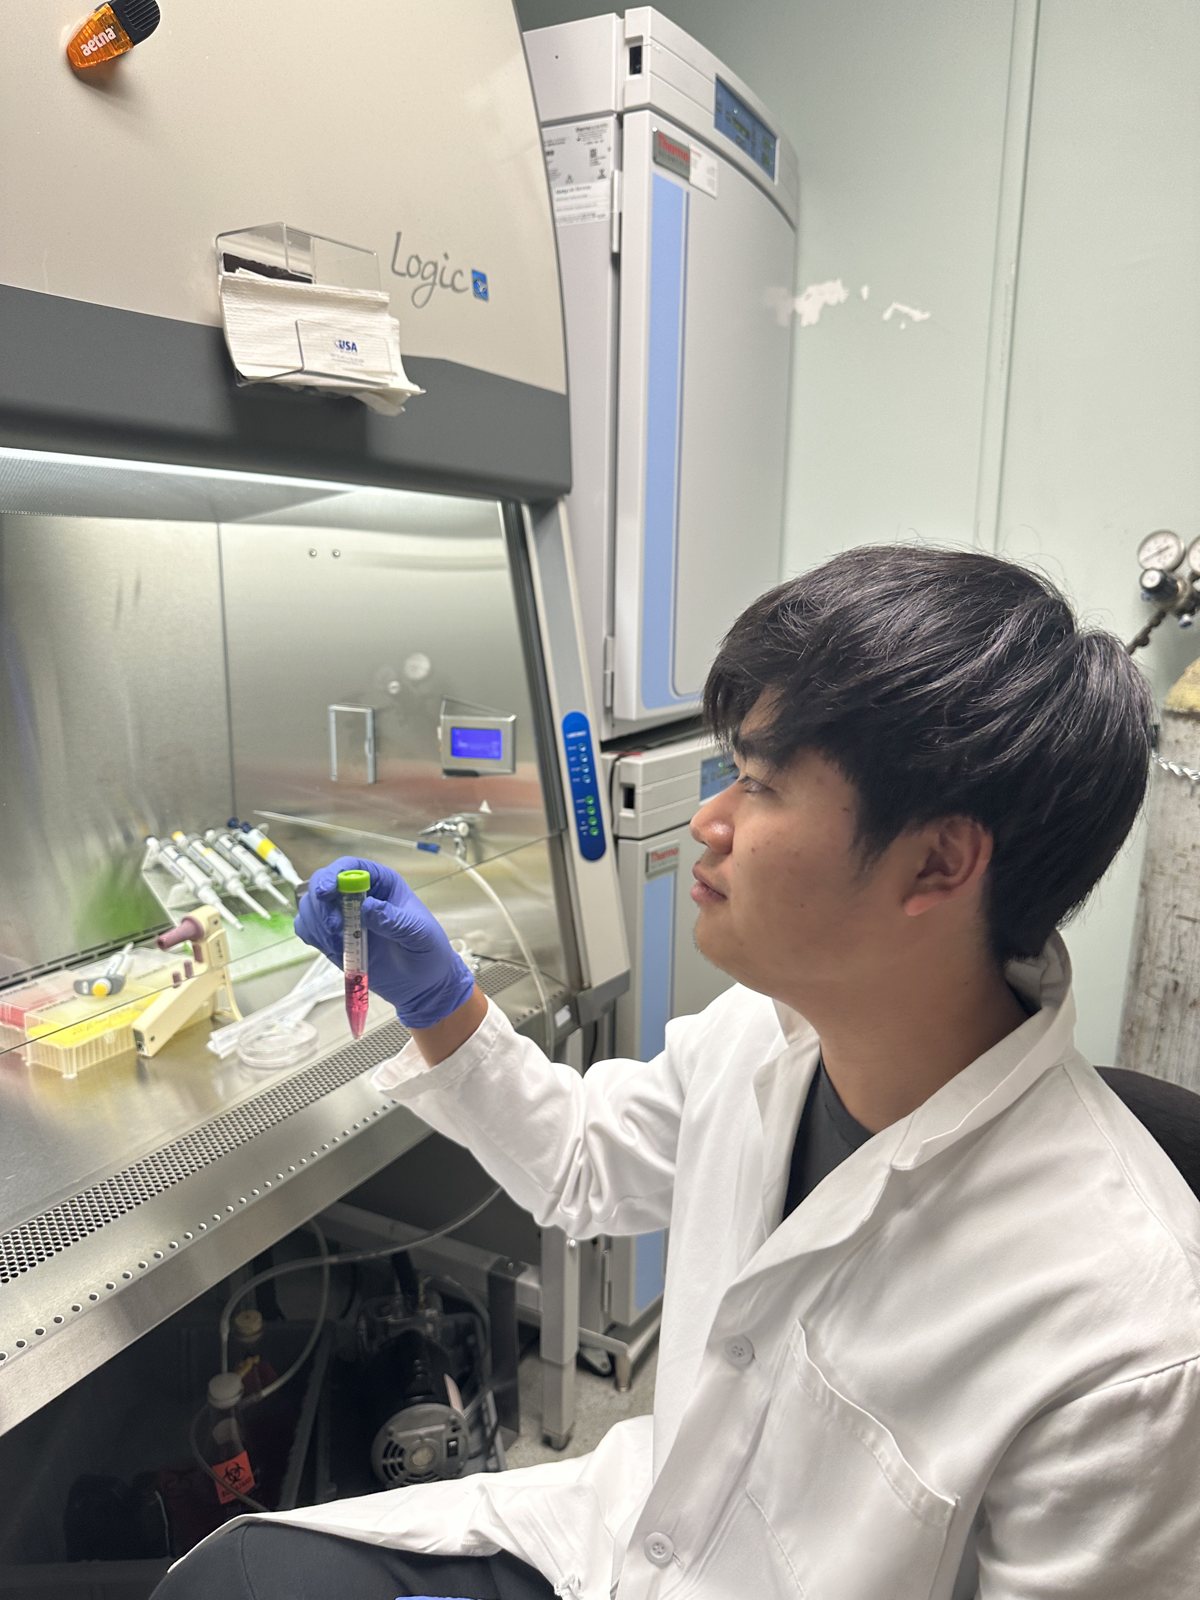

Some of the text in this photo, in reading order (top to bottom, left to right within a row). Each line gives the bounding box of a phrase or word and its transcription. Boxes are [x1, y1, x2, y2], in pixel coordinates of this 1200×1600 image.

[80, 26, 117, 57] aetna
[391, 231, 469, 309] Logic
[339, 339, 358, 352] USA
